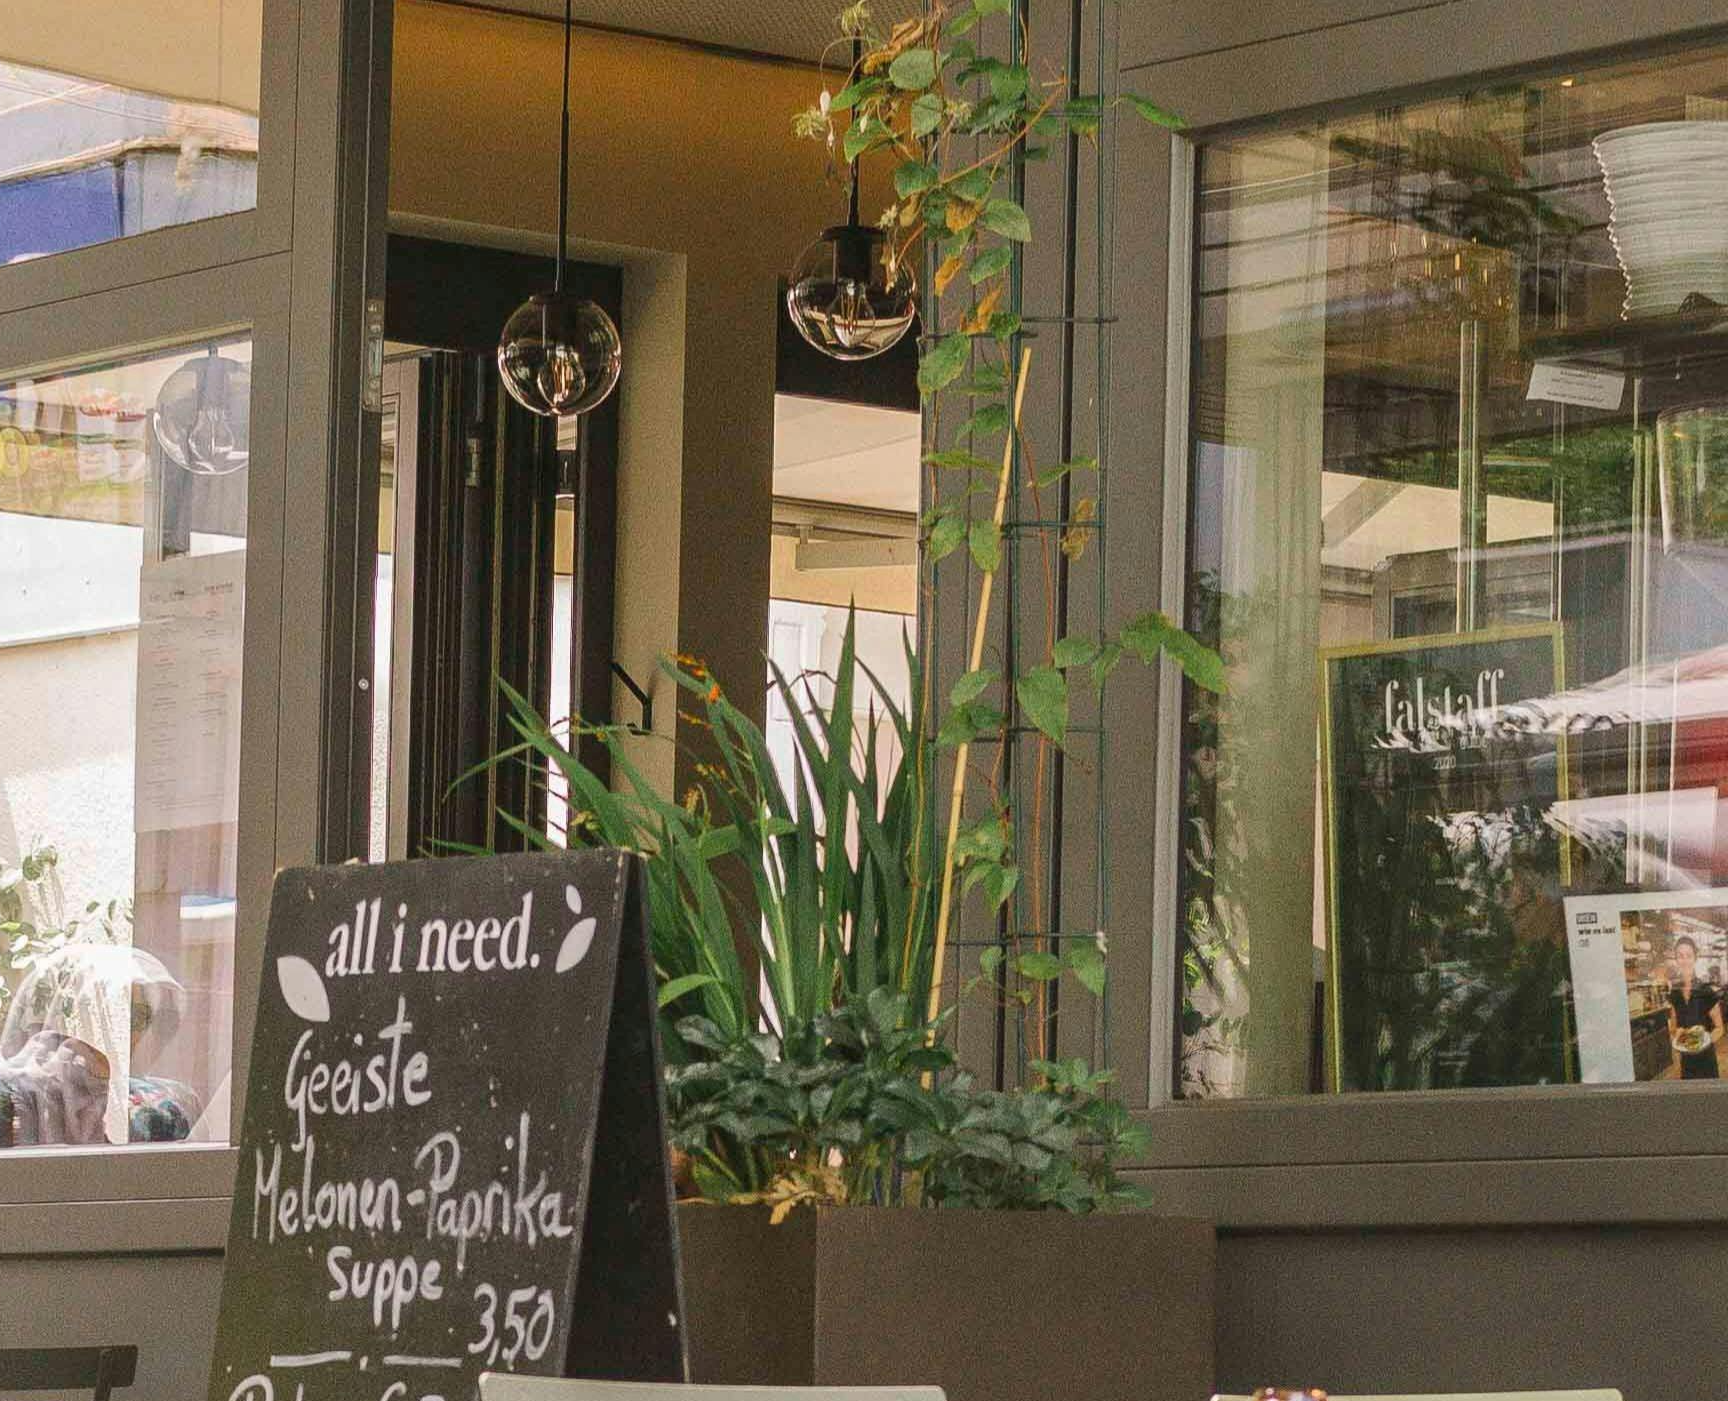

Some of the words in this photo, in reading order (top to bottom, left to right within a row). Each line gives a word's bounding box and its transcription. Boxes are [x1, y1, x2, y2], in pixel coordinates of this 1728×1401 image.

[1384, 668, 1505, 735] falstaff
[325, 897, 382, 977] all
[387, 903, 408, 974] i
[416, 891, 541, 973] need.
[285, 996, 432, 1151] Geeiste
[254, 1111, 573, 1272] Melonen-Paprika
[328, 1246, 444, 1331] Suppe
[468, 1283, 555, 1370] 3,50
